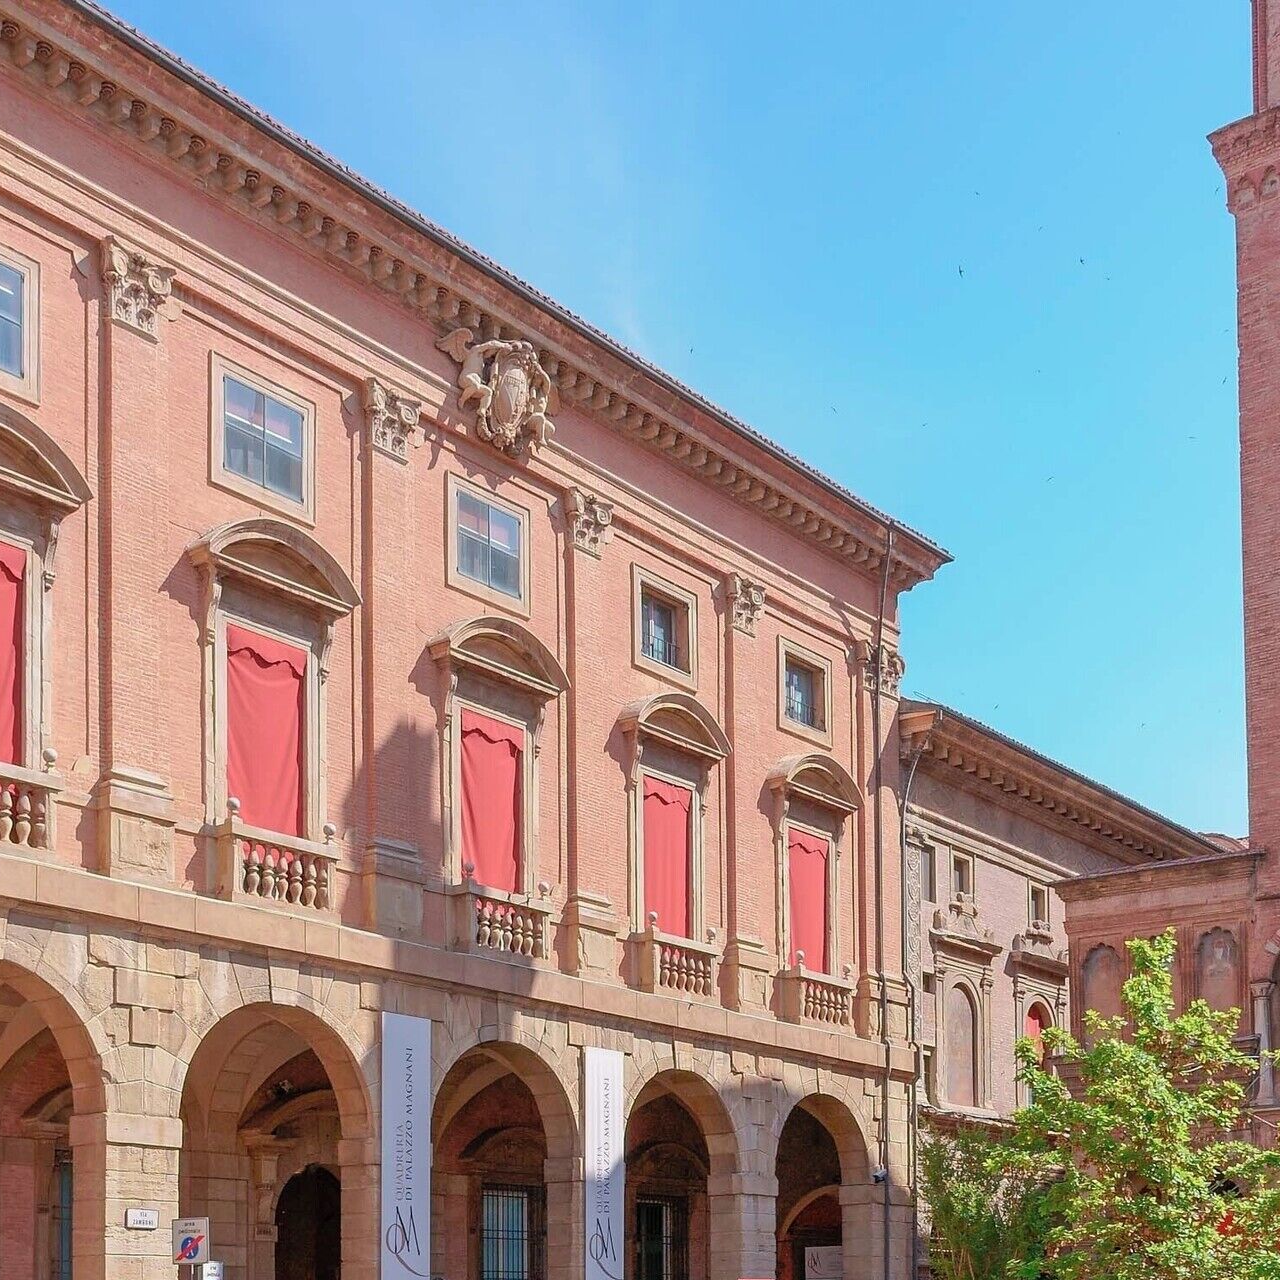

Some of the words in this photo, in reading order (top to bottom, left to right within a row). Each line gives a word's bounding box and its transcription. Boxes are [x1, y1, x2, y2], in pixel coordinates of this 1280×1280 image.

[405, 1047, 413, 1115] MAGNANI
[395, 1124, 405, 1201] QUADRERIA
[405, 1120, 413, 1180] PALAZZO
[405, 1187, 413, 1201] DI
